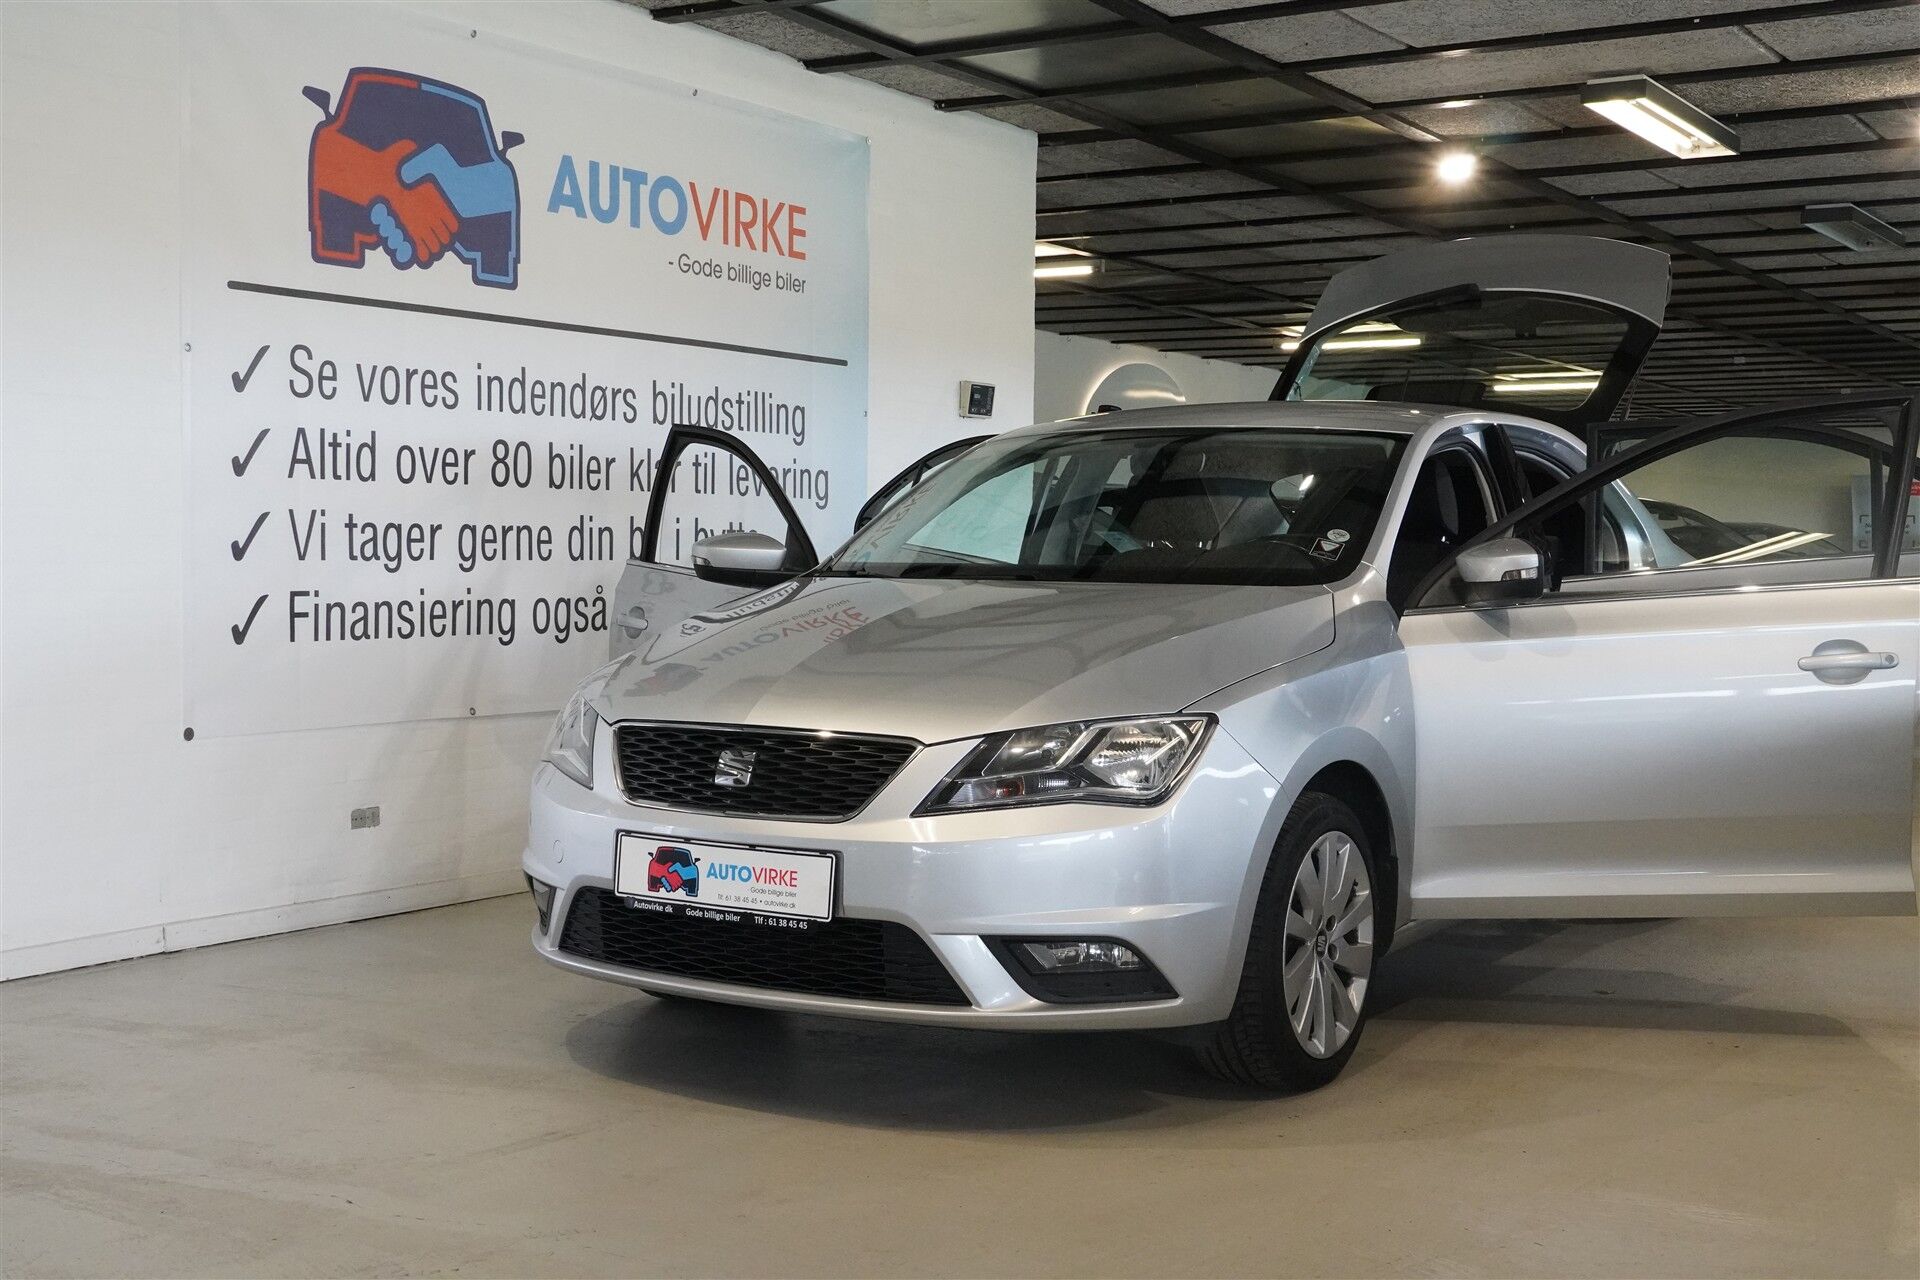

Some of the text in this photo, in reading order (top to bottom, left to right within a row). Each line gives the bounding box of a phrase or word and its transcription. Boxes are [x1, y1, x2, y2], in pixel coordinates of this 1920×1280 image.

[547, 154, 807, 261] AUTOVIRKE
[677, 253, 723, 279] Gode
[727, 262, 772, 291] billige
[775, 271, 806, 294] biler
[288, 344, 806, 447] Se vores indendørs biludstilling
[287, 426, 377, 482] Altid
[395, 444, 477, 485] over
[490, 438, 532, 489] 80
[548, 441, 617, 492] biler
[629, 447, 682, 493] klr
[692, 451, 716, 495] til
[288, 508, 327, 561] Vi
[344, 513, 443, 573] tager
[457, 523, 553, 573] gerne
[567, 515, 614, 561] din
[674, 516, 681, 561] i
[289, 584, 609, 646] Finansiering også
[706, 862, 798, 888] AUTOVIRKE
[750, 886, 797, 898] Gode billige biler
[685, 908, 703, 917] Gode
[704, 911, 725, 922] billige
[725, 912, 741, 922] biler
[768, 917, 777, 926] 61
[778, 918, 788, 927] 38
[788, 920, 798, 929] 45
[798, 921, 808, 930] 45
